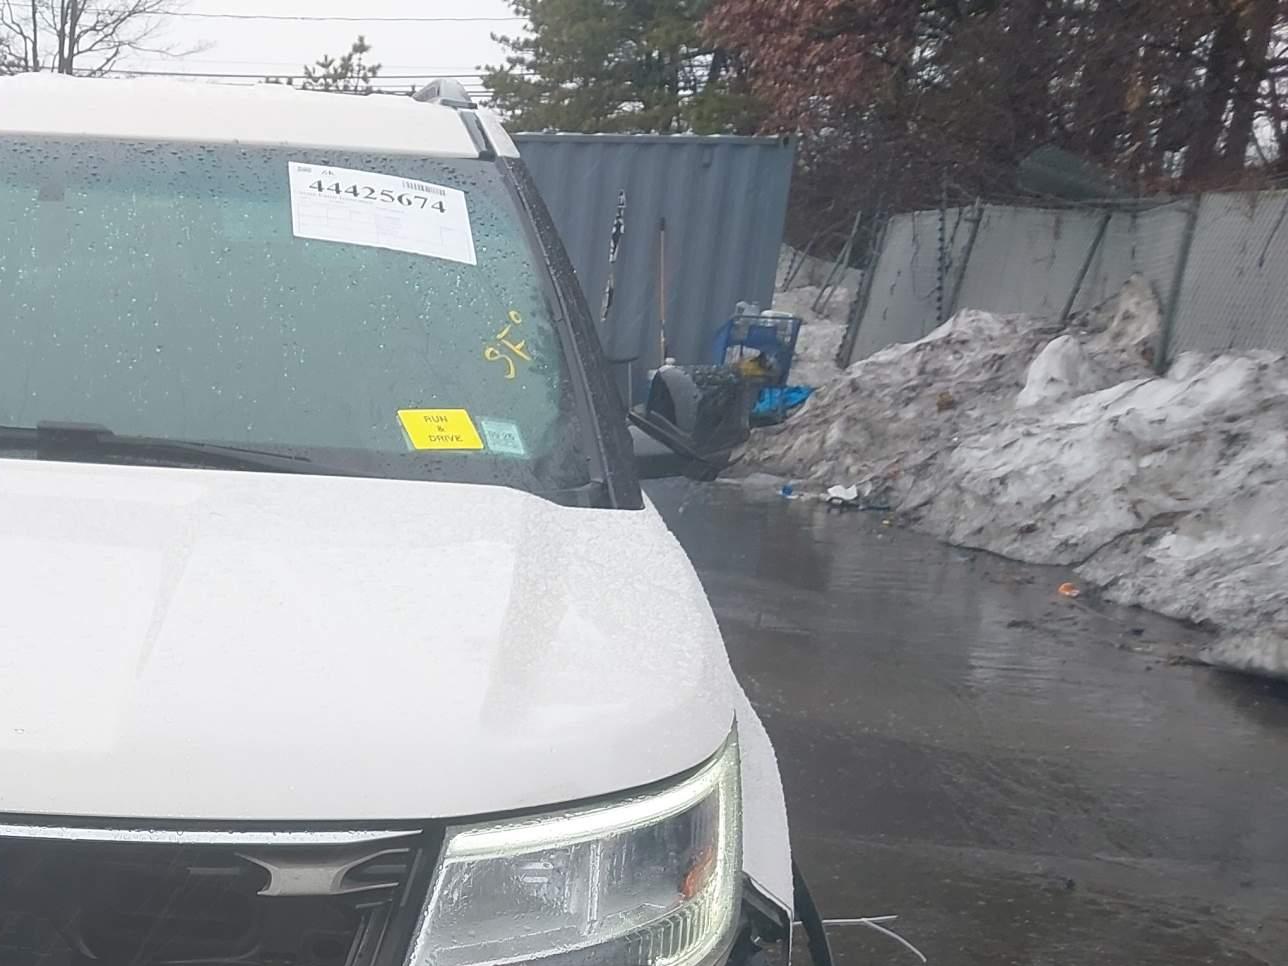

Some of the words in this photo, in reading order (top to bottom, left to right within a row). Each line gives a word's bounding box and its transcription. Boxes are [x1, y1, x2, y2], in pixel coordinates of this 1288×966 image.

[308, 179, 447, 213] 44425674
[423, 415, 448, 423] RUN
[427, 434, 464, 442] DRIVE
